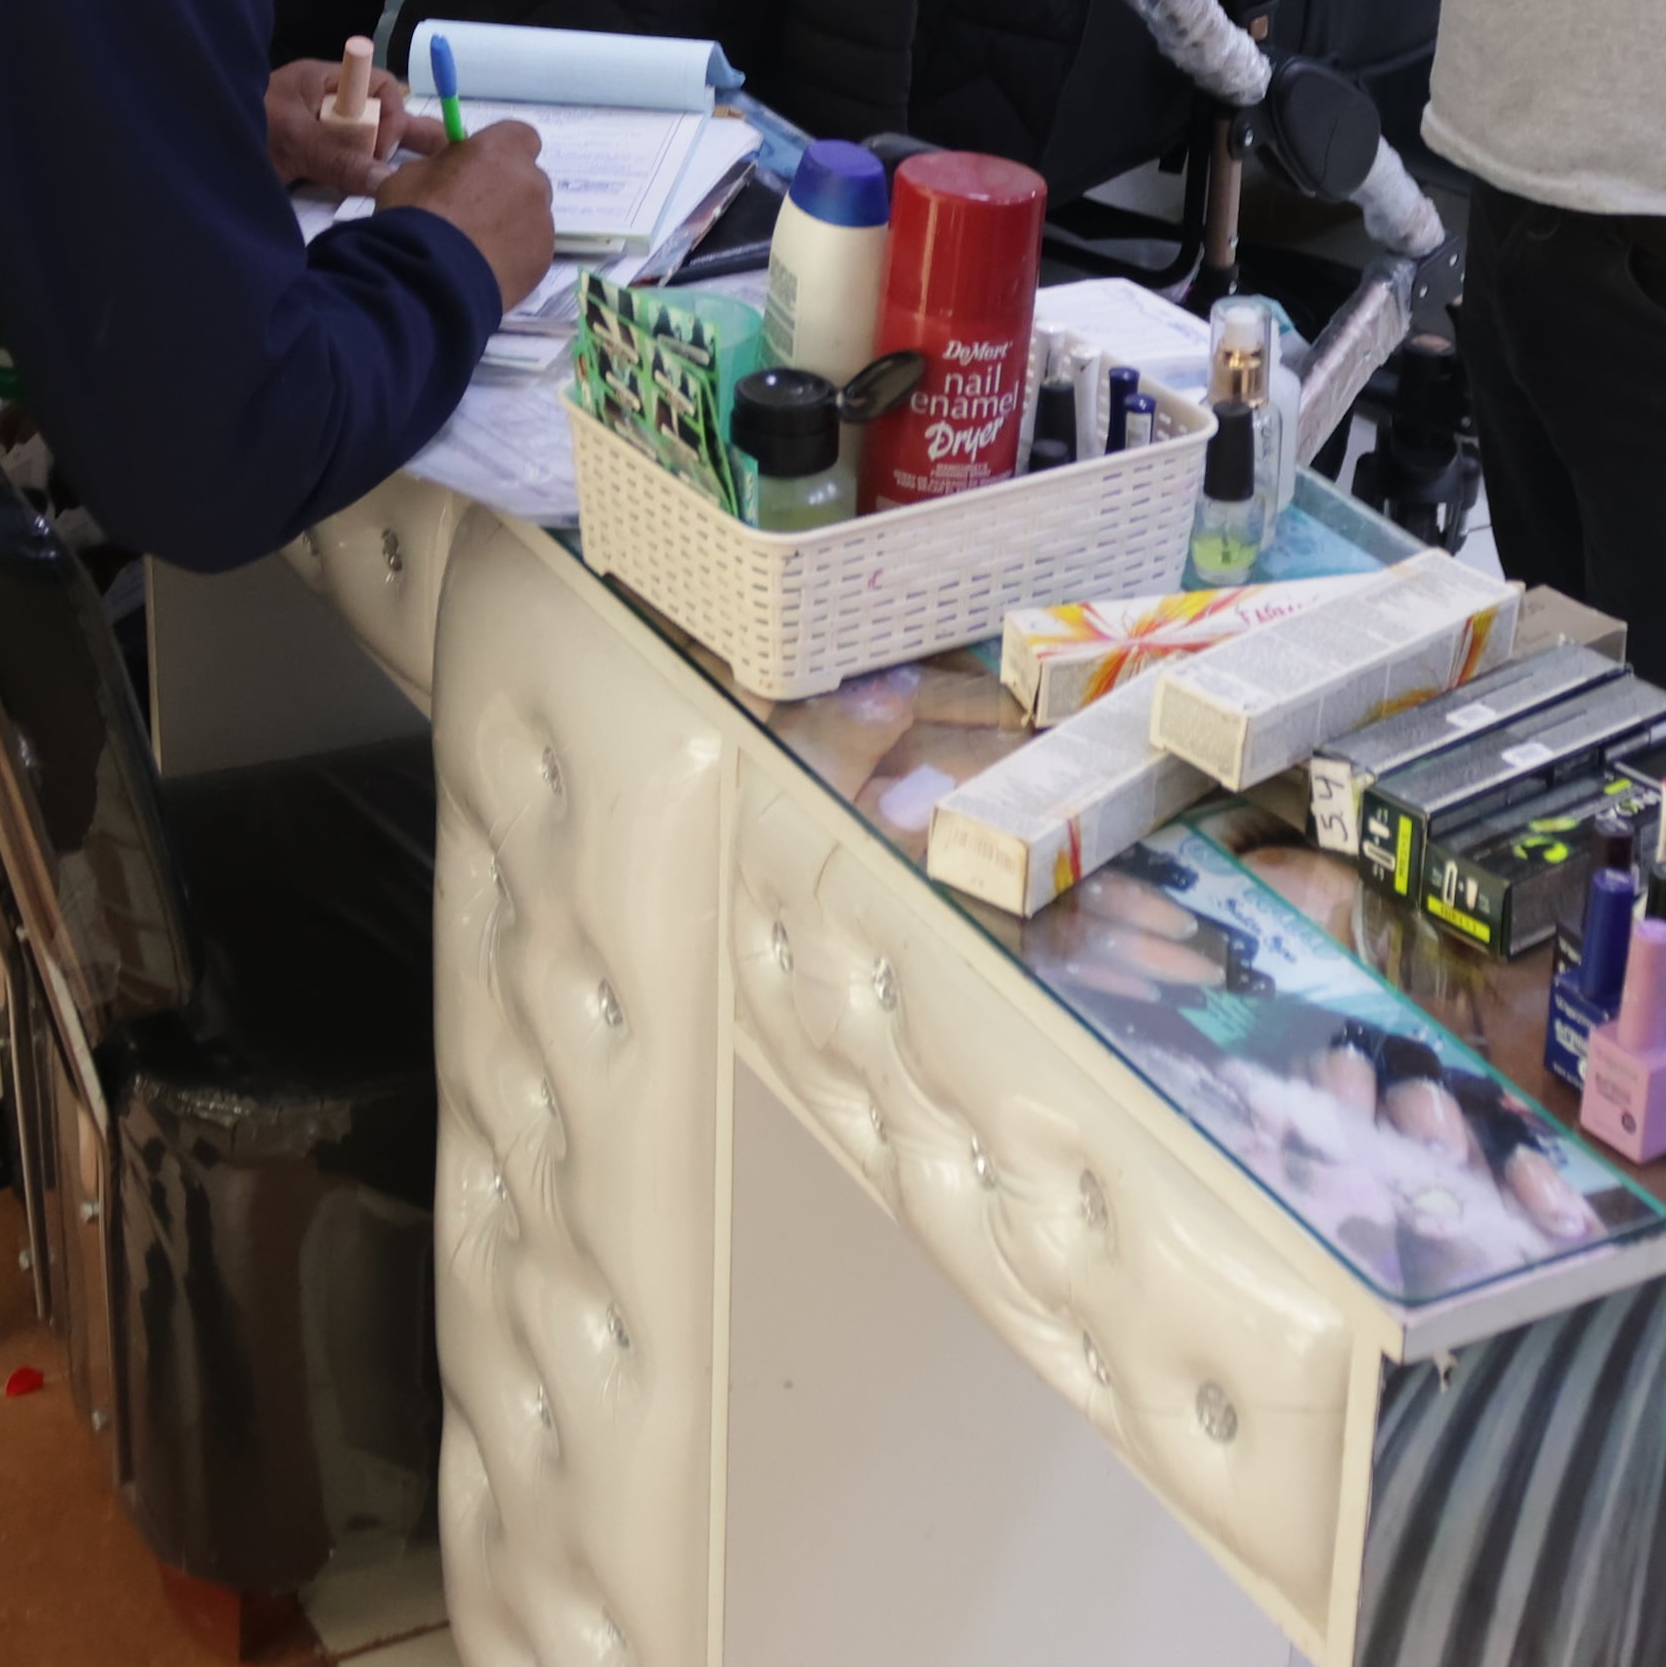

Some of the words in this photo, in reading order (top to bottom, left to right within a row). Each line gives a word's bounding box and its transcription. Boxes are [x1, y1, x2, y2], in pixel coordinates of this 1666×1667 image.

[944, 362, 1002, 395] nail
[910, 380, 1019, 419] enamel
[924, 419, 1004, 463] Dryer
